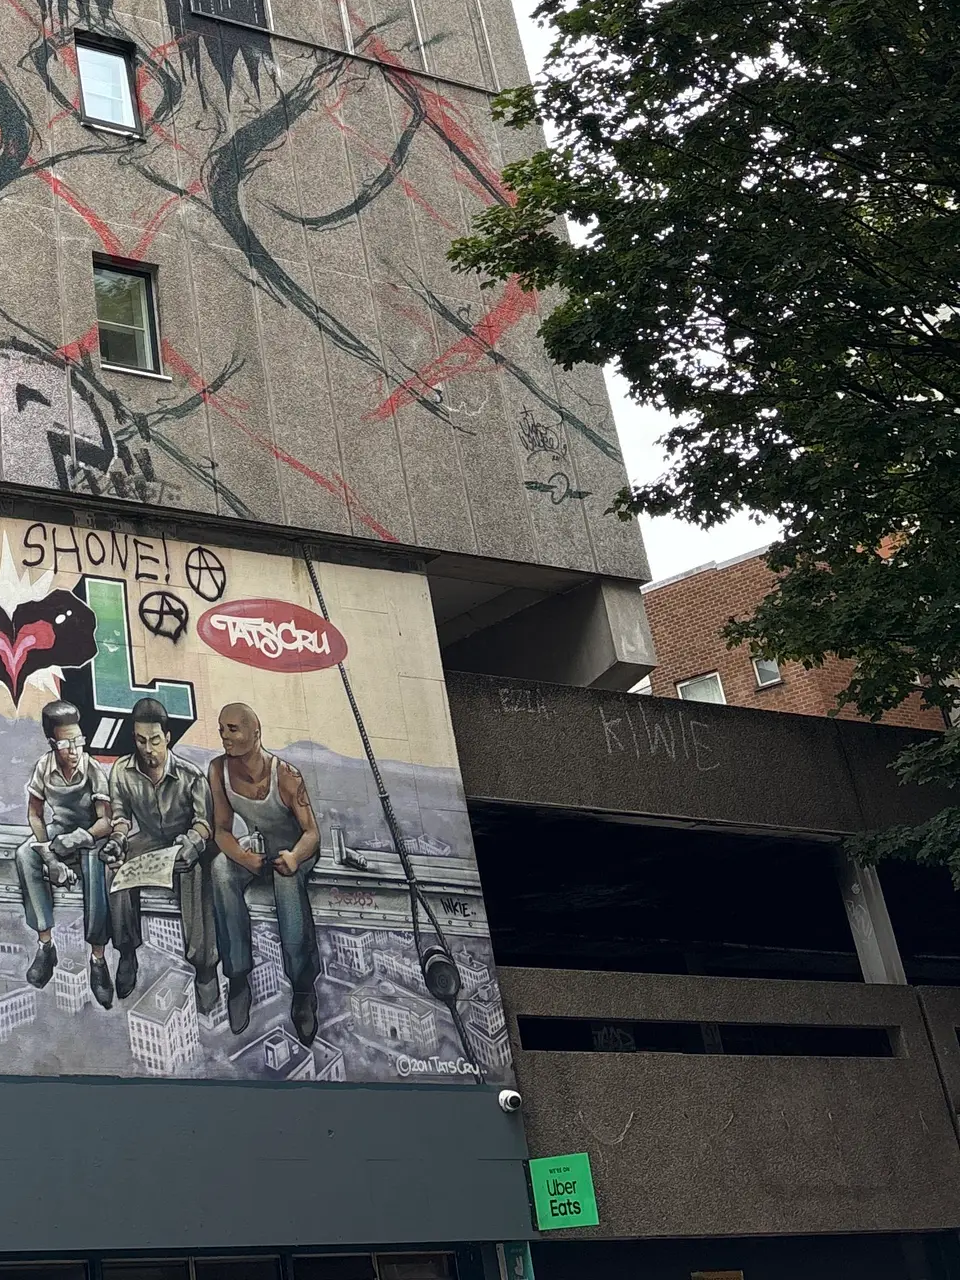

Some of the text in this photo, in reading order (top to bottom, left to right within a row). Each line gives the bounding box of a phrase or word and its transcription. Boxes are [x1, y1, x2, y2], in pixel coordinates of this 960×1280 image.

[22, 523, 172, 585] SHONE!
[546, 1179, 577, 1197] Uber
[549, 1199, 581, 1217] Eats
